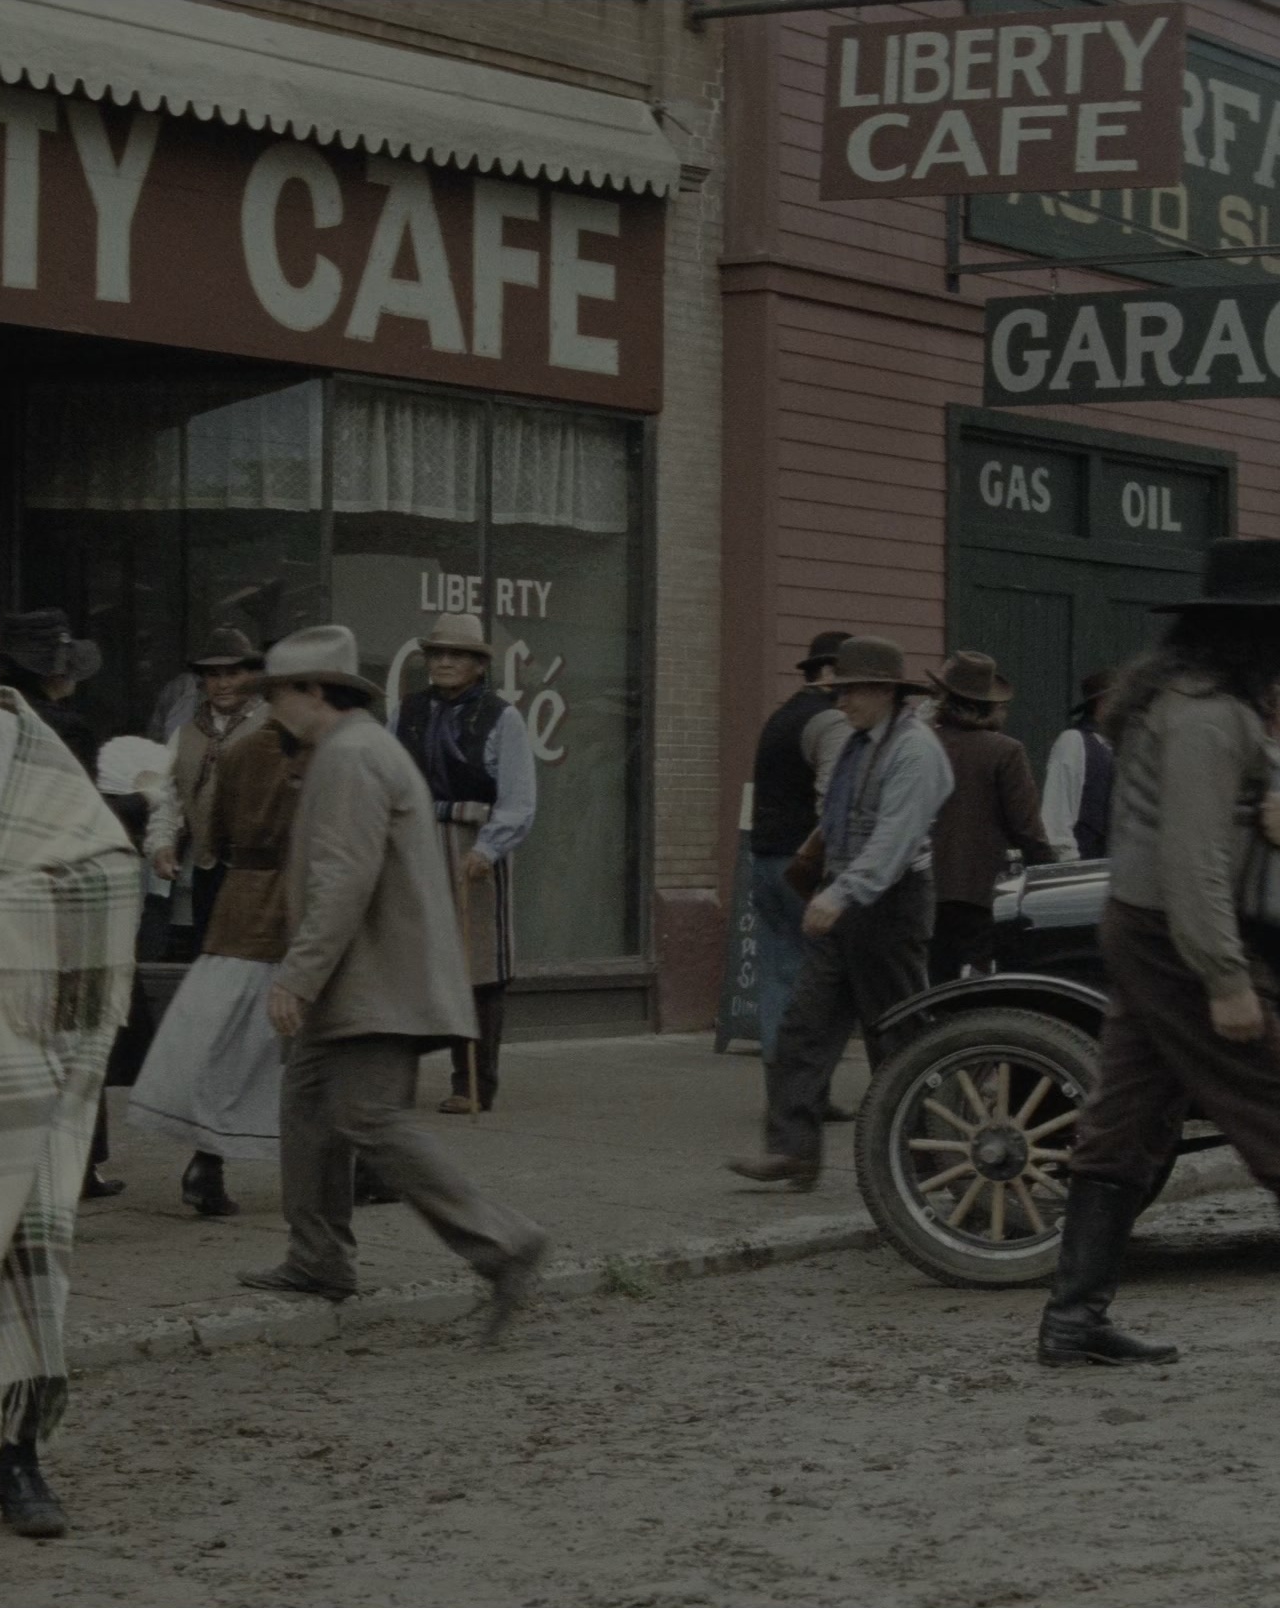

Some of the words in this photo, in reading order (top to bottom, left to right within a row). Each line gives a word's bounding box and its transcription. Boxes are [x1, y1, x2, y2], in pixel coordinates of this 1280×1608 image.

[838, 17, 1169, 107] LIBERTY
[846, 101, 1142, 182] CAFE
[241, 140, 619, 376] CAFE
[979, 459, 1051, 513] GAS
[1122, 481, 1182, 532] OIL
[420, 571, 552, 618] LIBERTY
